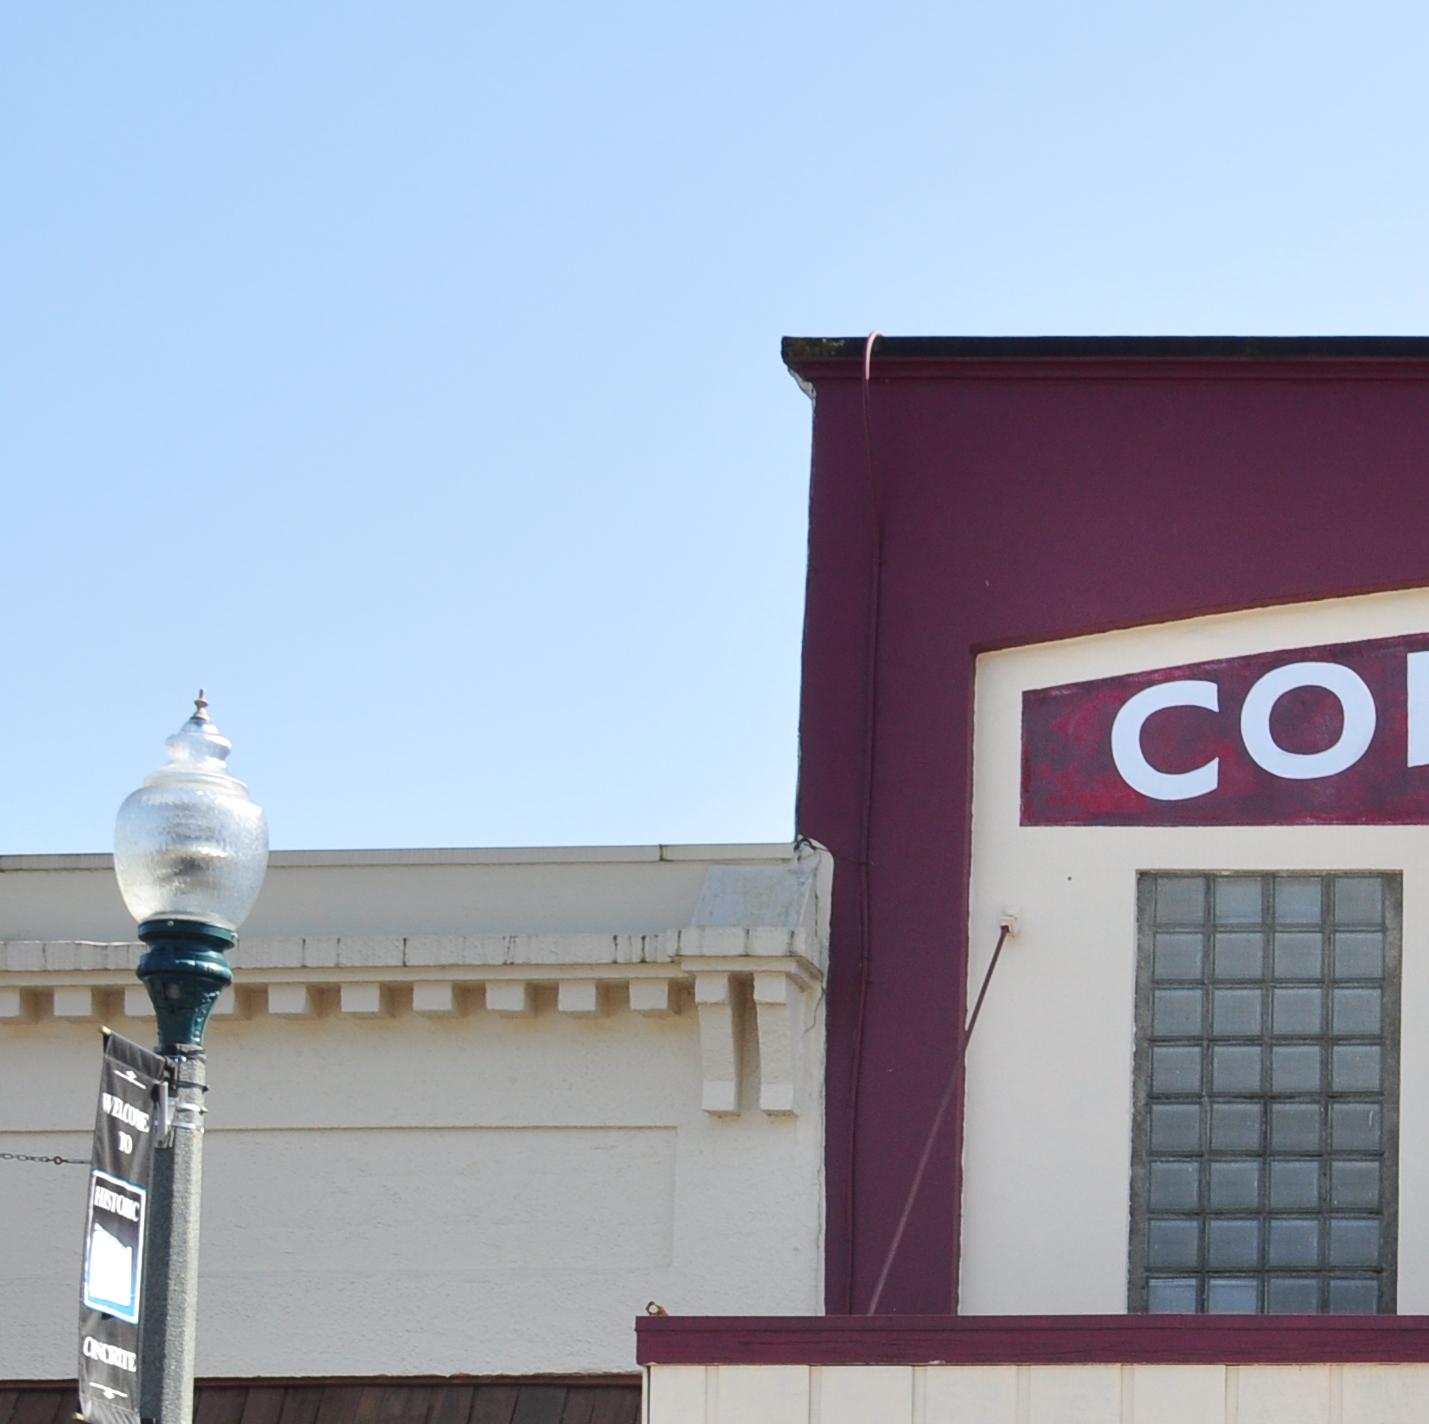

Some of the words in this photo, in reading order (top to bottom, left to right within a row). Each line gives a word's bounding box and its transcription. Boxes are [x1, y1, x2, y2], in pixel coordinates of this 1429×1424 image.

[102, 1092, 150, 1134] WELCOME
[119, 1131, 133, 1155] TO
[94, 1185, 140, 1222] HISTORIC
